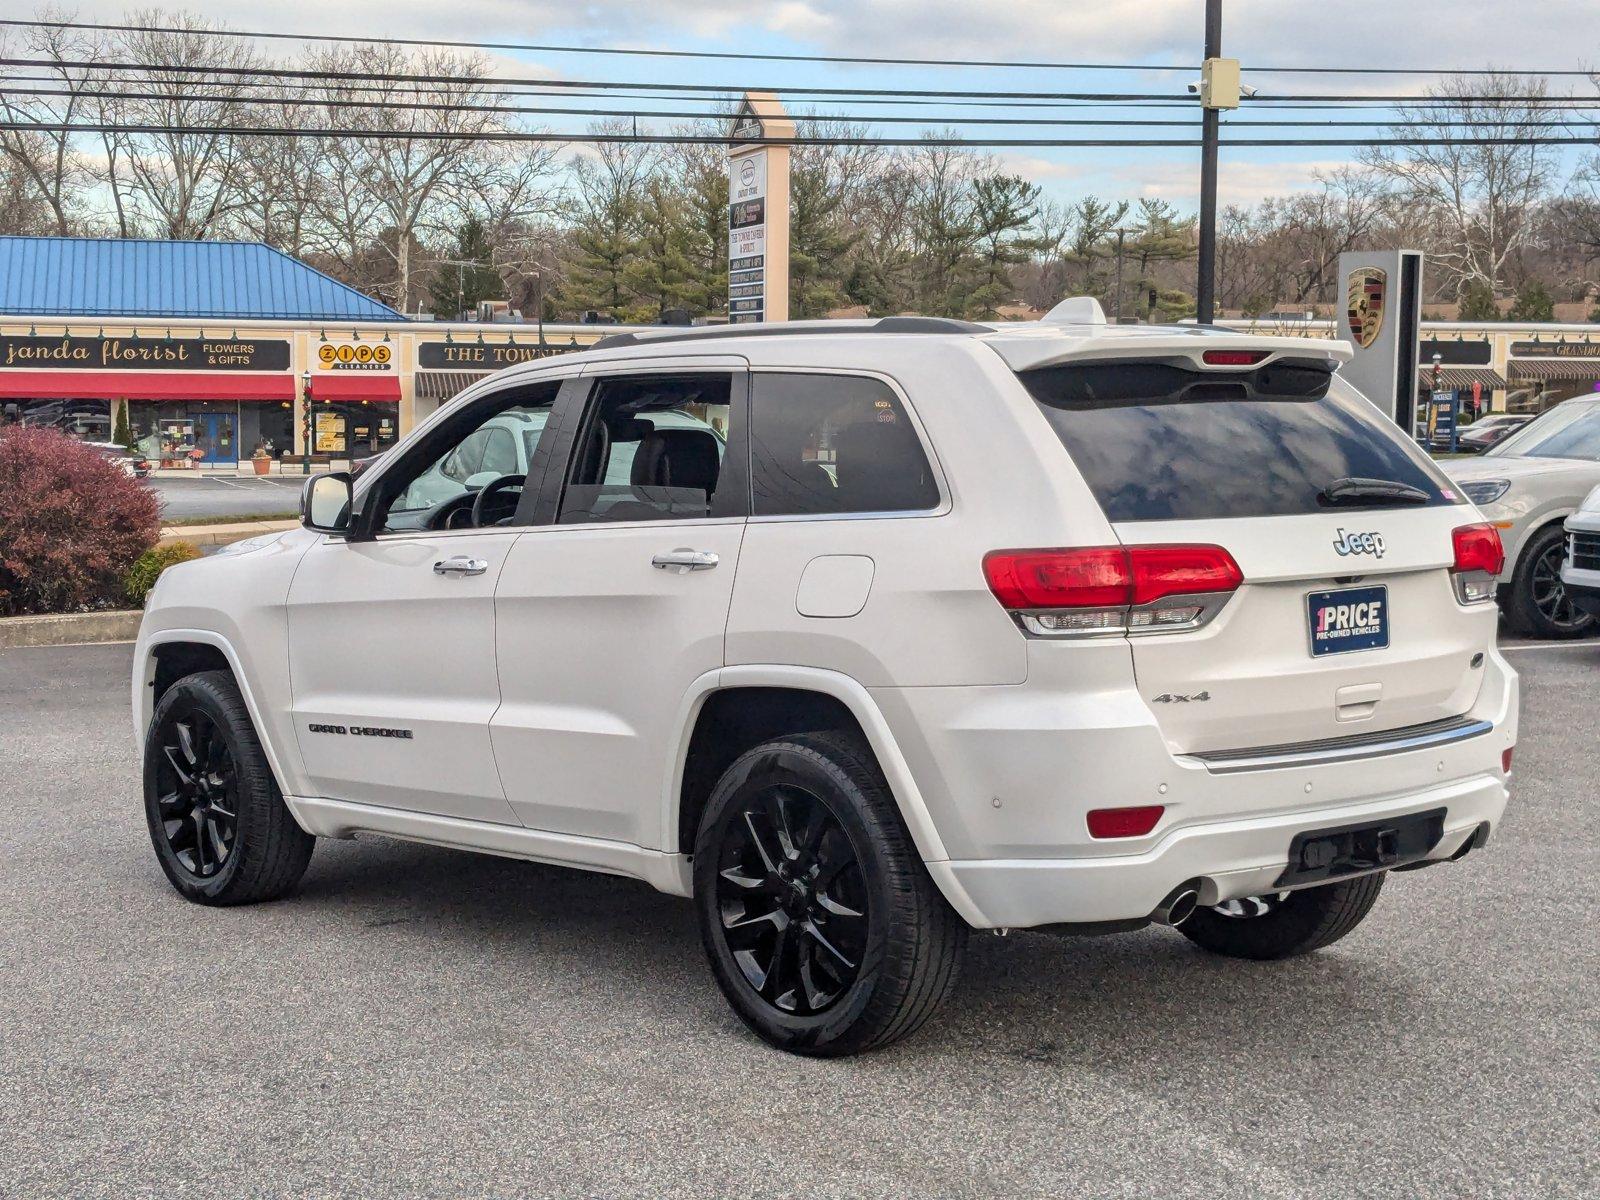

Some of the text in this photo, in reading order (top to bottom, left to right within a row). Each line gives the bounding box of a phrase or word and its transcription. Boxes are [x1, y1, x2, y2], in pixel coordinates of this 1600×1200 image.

[6, 340, 189, 365] janda florist
[203, 344, 255, 354] FLOWERS
[321, 346, 389, 361] ZIPS
[444, 347, 485, 362] THE
[208, 355, 251, 365] & GIFTS
[1333, 528, 1386, 559] Jeep
[1351, 625, 1381, 636] VEHICLES
[1151, 691, 1211, 703] 4x4
[308, 723, 414, 739] GRAND CHEROKEE
